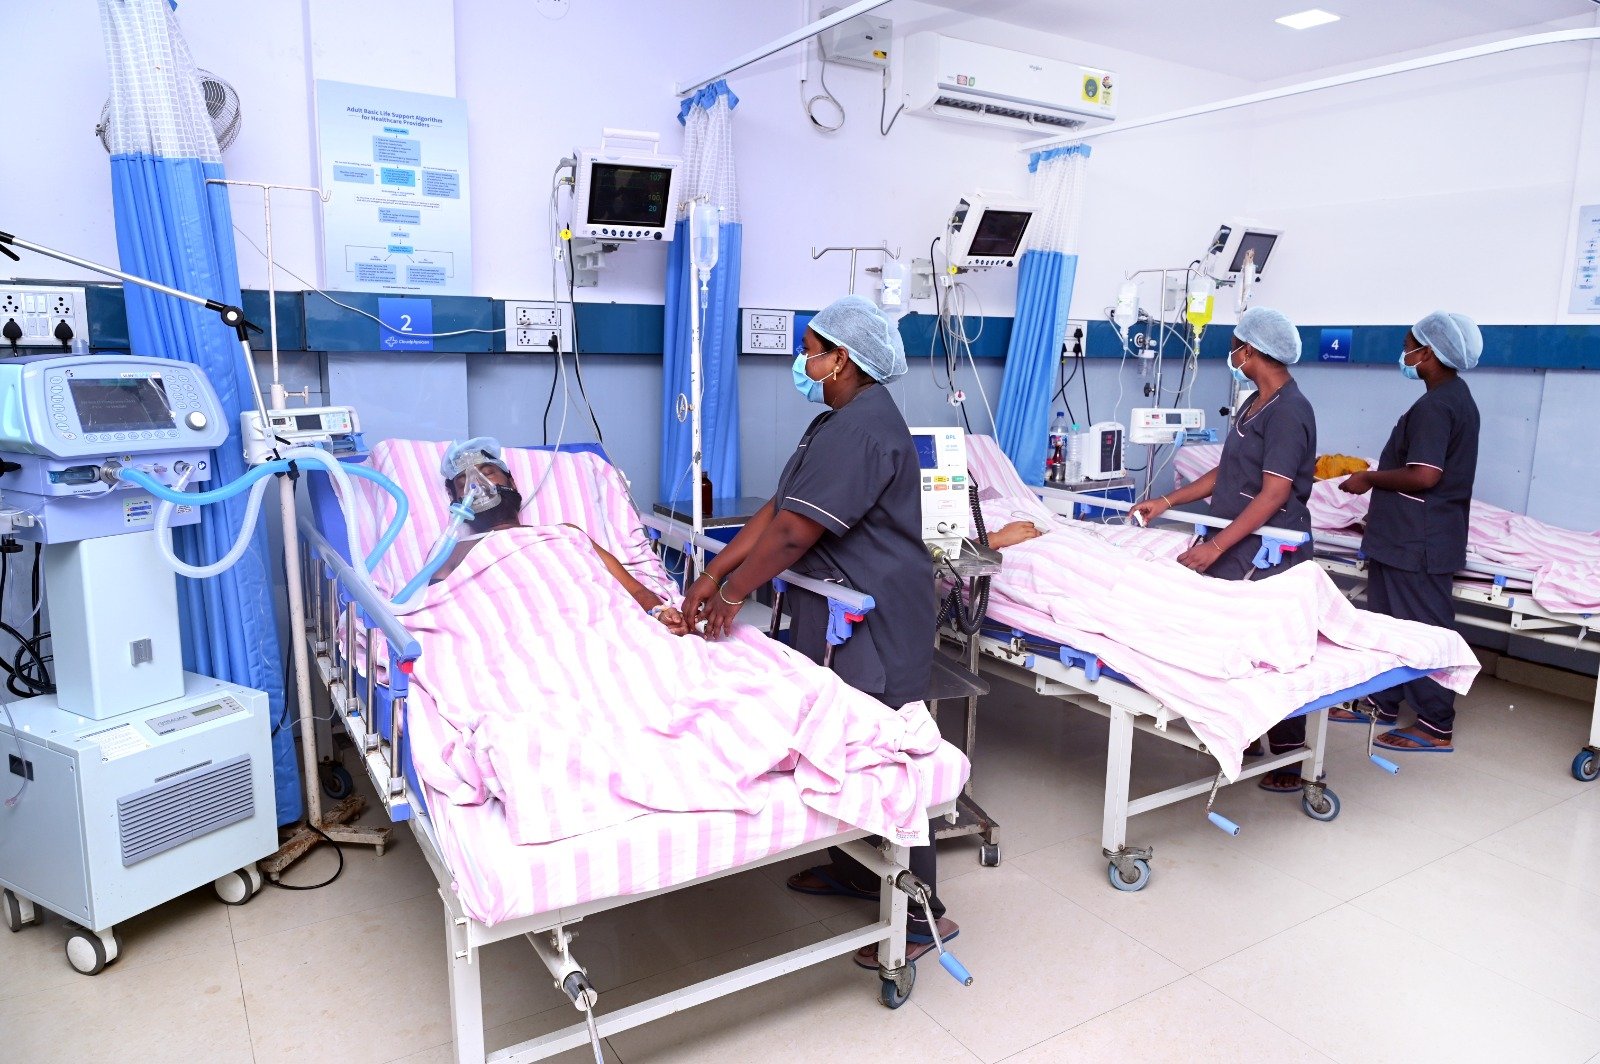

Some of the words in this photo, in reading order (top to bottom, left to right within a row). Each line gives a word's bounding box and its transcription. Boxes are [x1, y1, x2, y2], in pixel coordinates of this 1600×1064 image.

[346, 106, 362, 114] Adult
[363, 108, 379, 116] Basic
[391, 112, 414, 121] Support
[415, 115, 443, 124] Algorithm
[371, 116, 402, 125] Healthcare
[403, 119, 430, 128] Providers
[649, 173, 662, 181] 107
[400, 314, 413, 332] 2
[1331, 339, 1339, 350] 4
